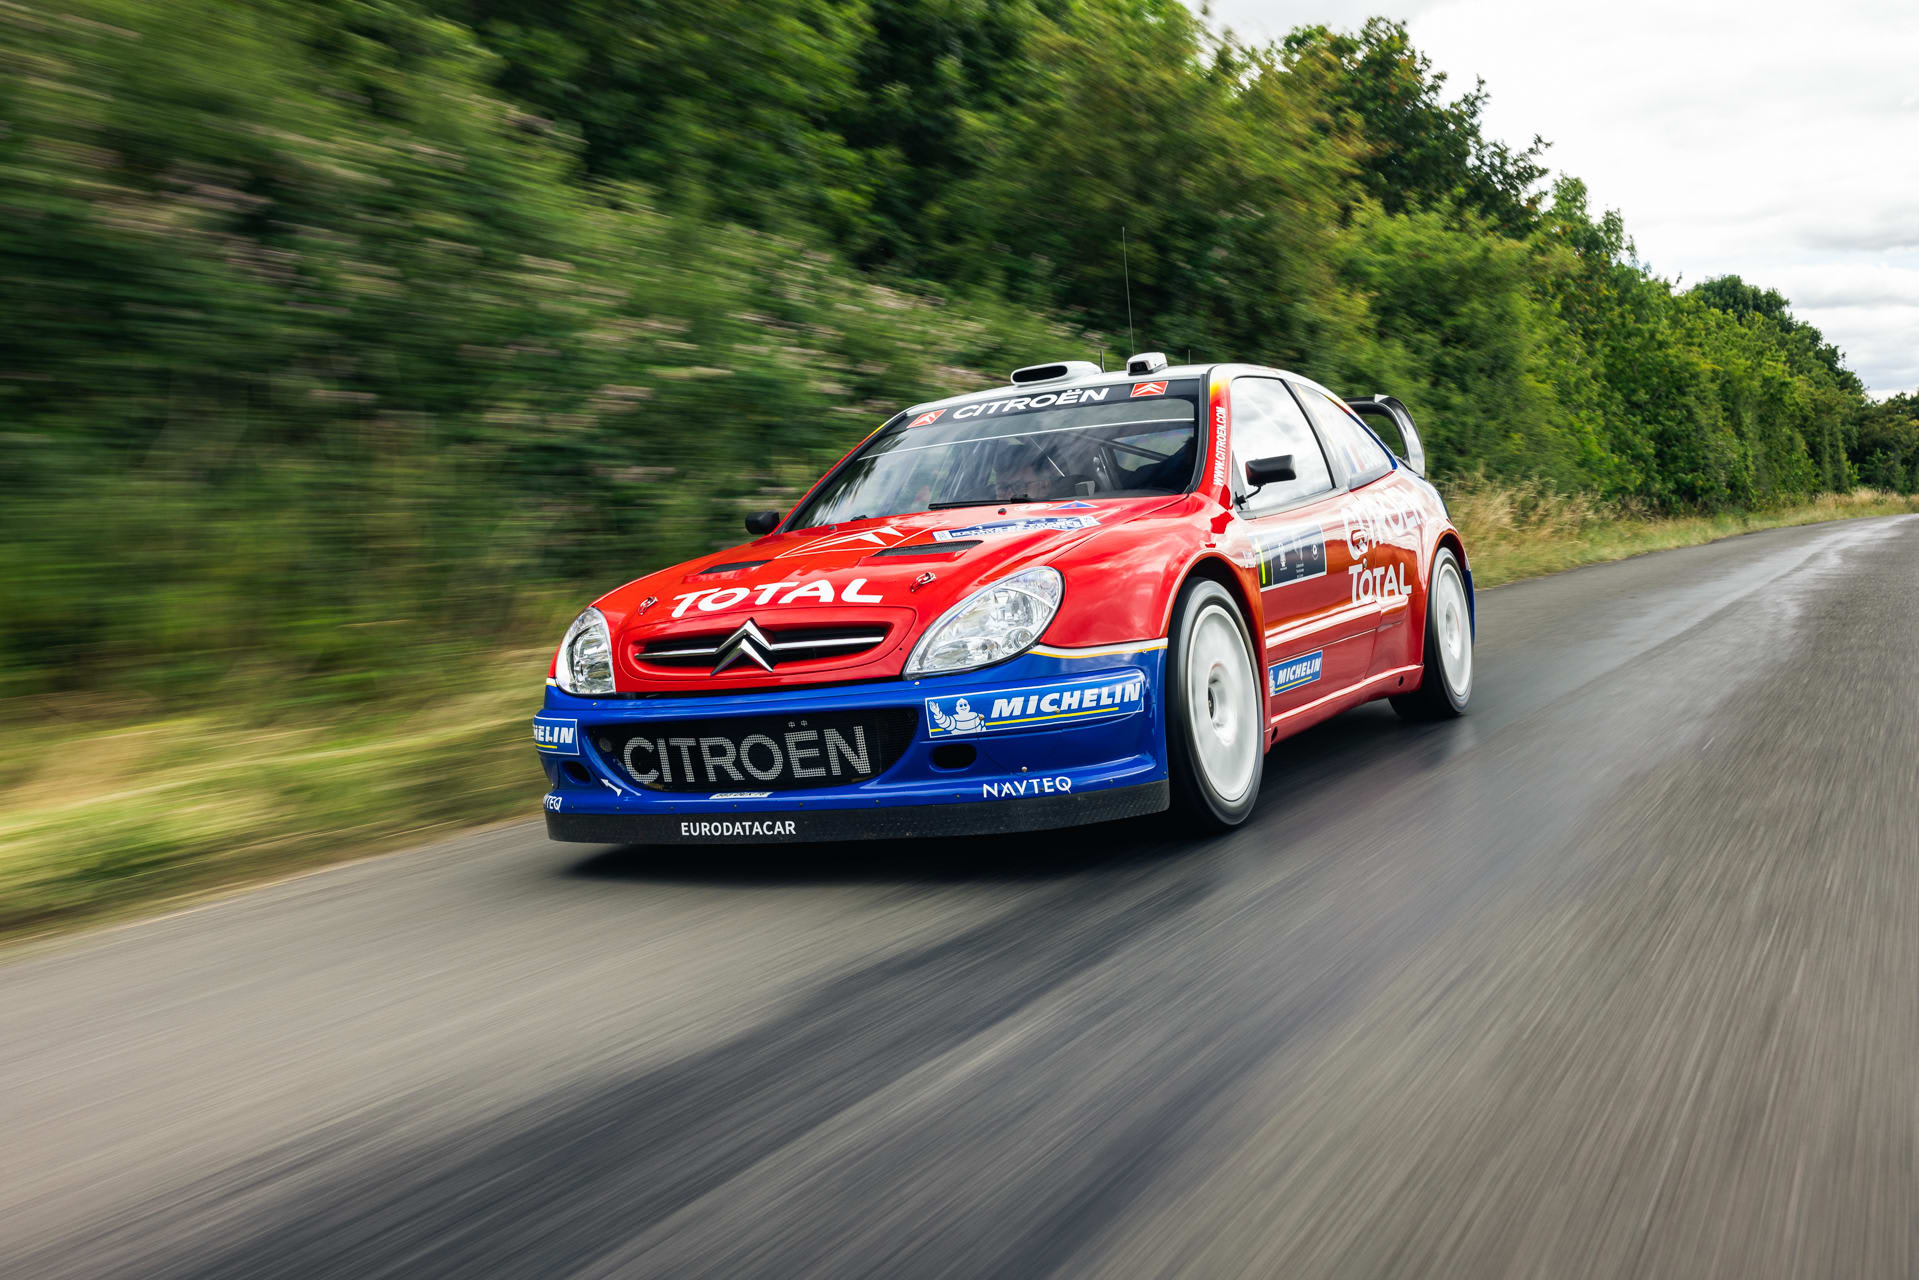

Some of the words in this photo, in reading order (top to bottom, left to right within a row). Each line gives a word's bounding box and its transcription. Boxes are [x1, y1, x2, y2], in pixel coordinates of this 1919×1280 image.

[953, 387, 1110, 419] CITROËN
[1213, 406, 1227, 487] WWW.CITROEN.COM
[671, 578, 884, 618] TOTAL
[1348, 562, 1412, 607] TOTAL
[1277, 657, 1322, 686] MICHELIN
[990, 682, 1141, 719] MICHELIN
[623, 720, 872, 784] CITROËN
[983, 776, 1072, 798] NAVTEQ
[681, 821, 797, 836] EURODATACAR
